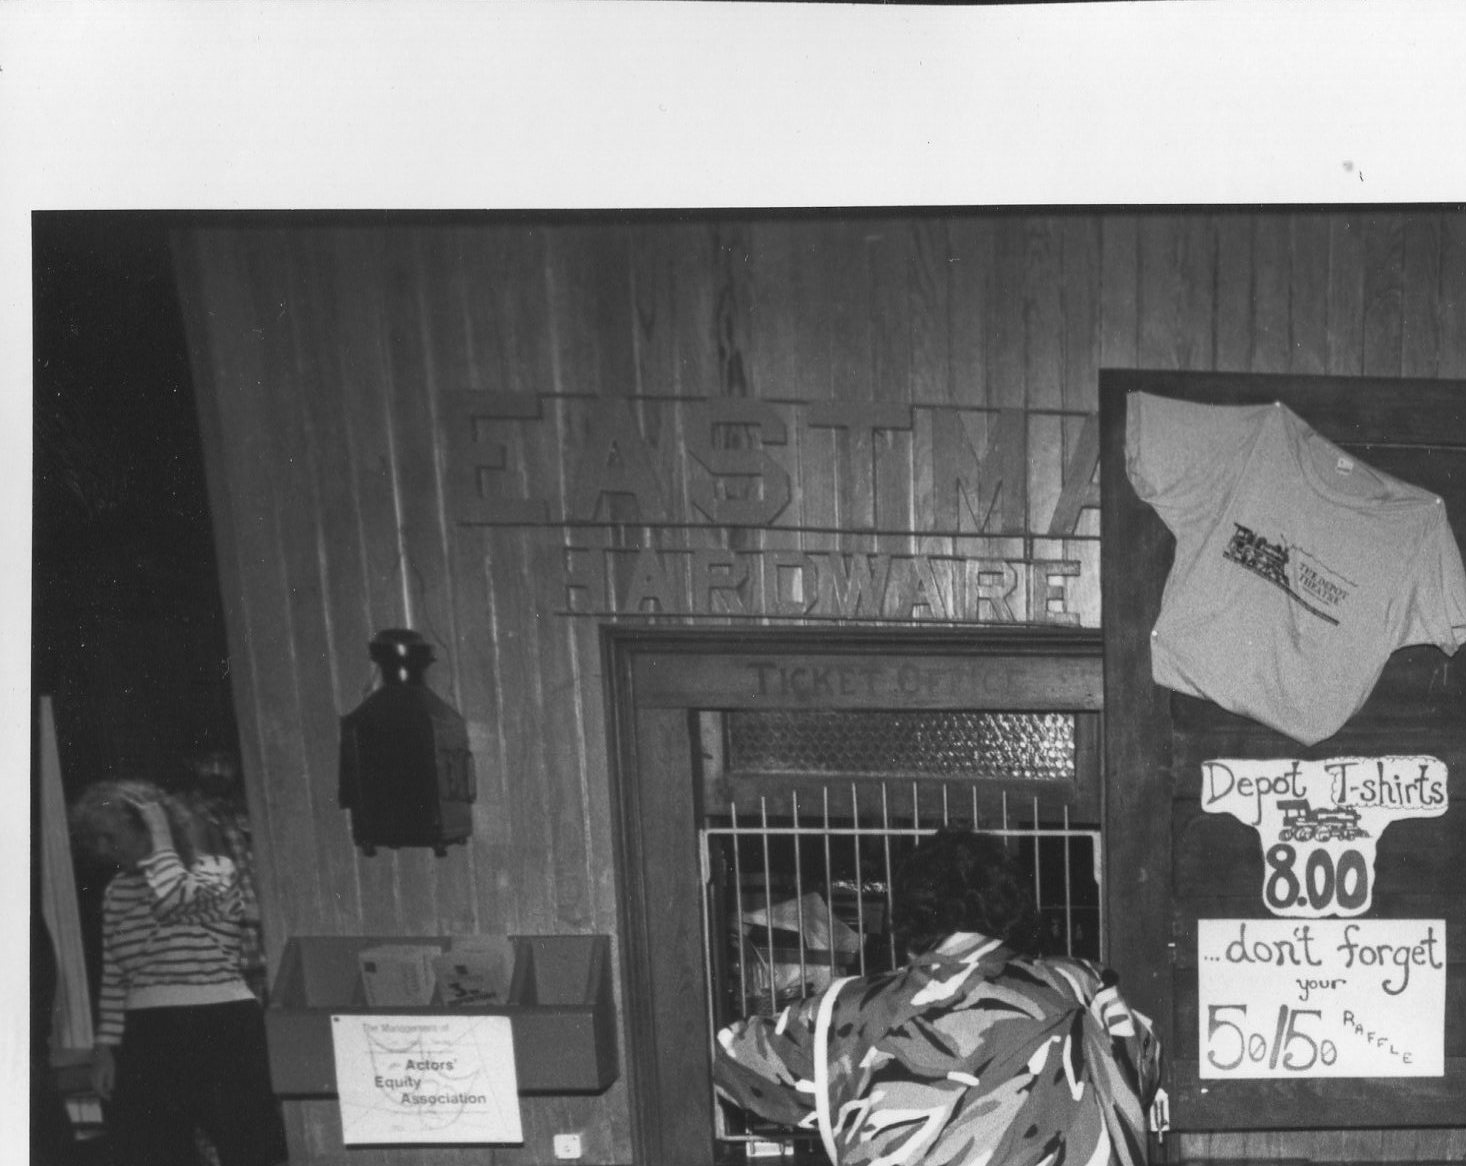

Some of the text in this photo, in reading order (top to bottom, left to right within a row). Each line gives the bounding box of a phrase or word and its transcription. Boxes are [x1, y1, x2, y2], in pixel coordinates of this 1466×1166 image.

[1318, 576, 1351, 600] DEPOT
[748, 661, 883, 697] TICKET
[1202, 760, 1445, 826] Depot T-shirts
[1265, 843, 1369, 911] 8.00
[1336, 923, 1444, 997] forget
[1295, 977, 1348, 1002] your
[1206, 1003, 1414, 1072] 50/50 RAFFLE
[404, 1057, 458, 1072] Actors'
[373, 1075, 422, 1091] Equity
[400, 1092, 488, 1106] Association
